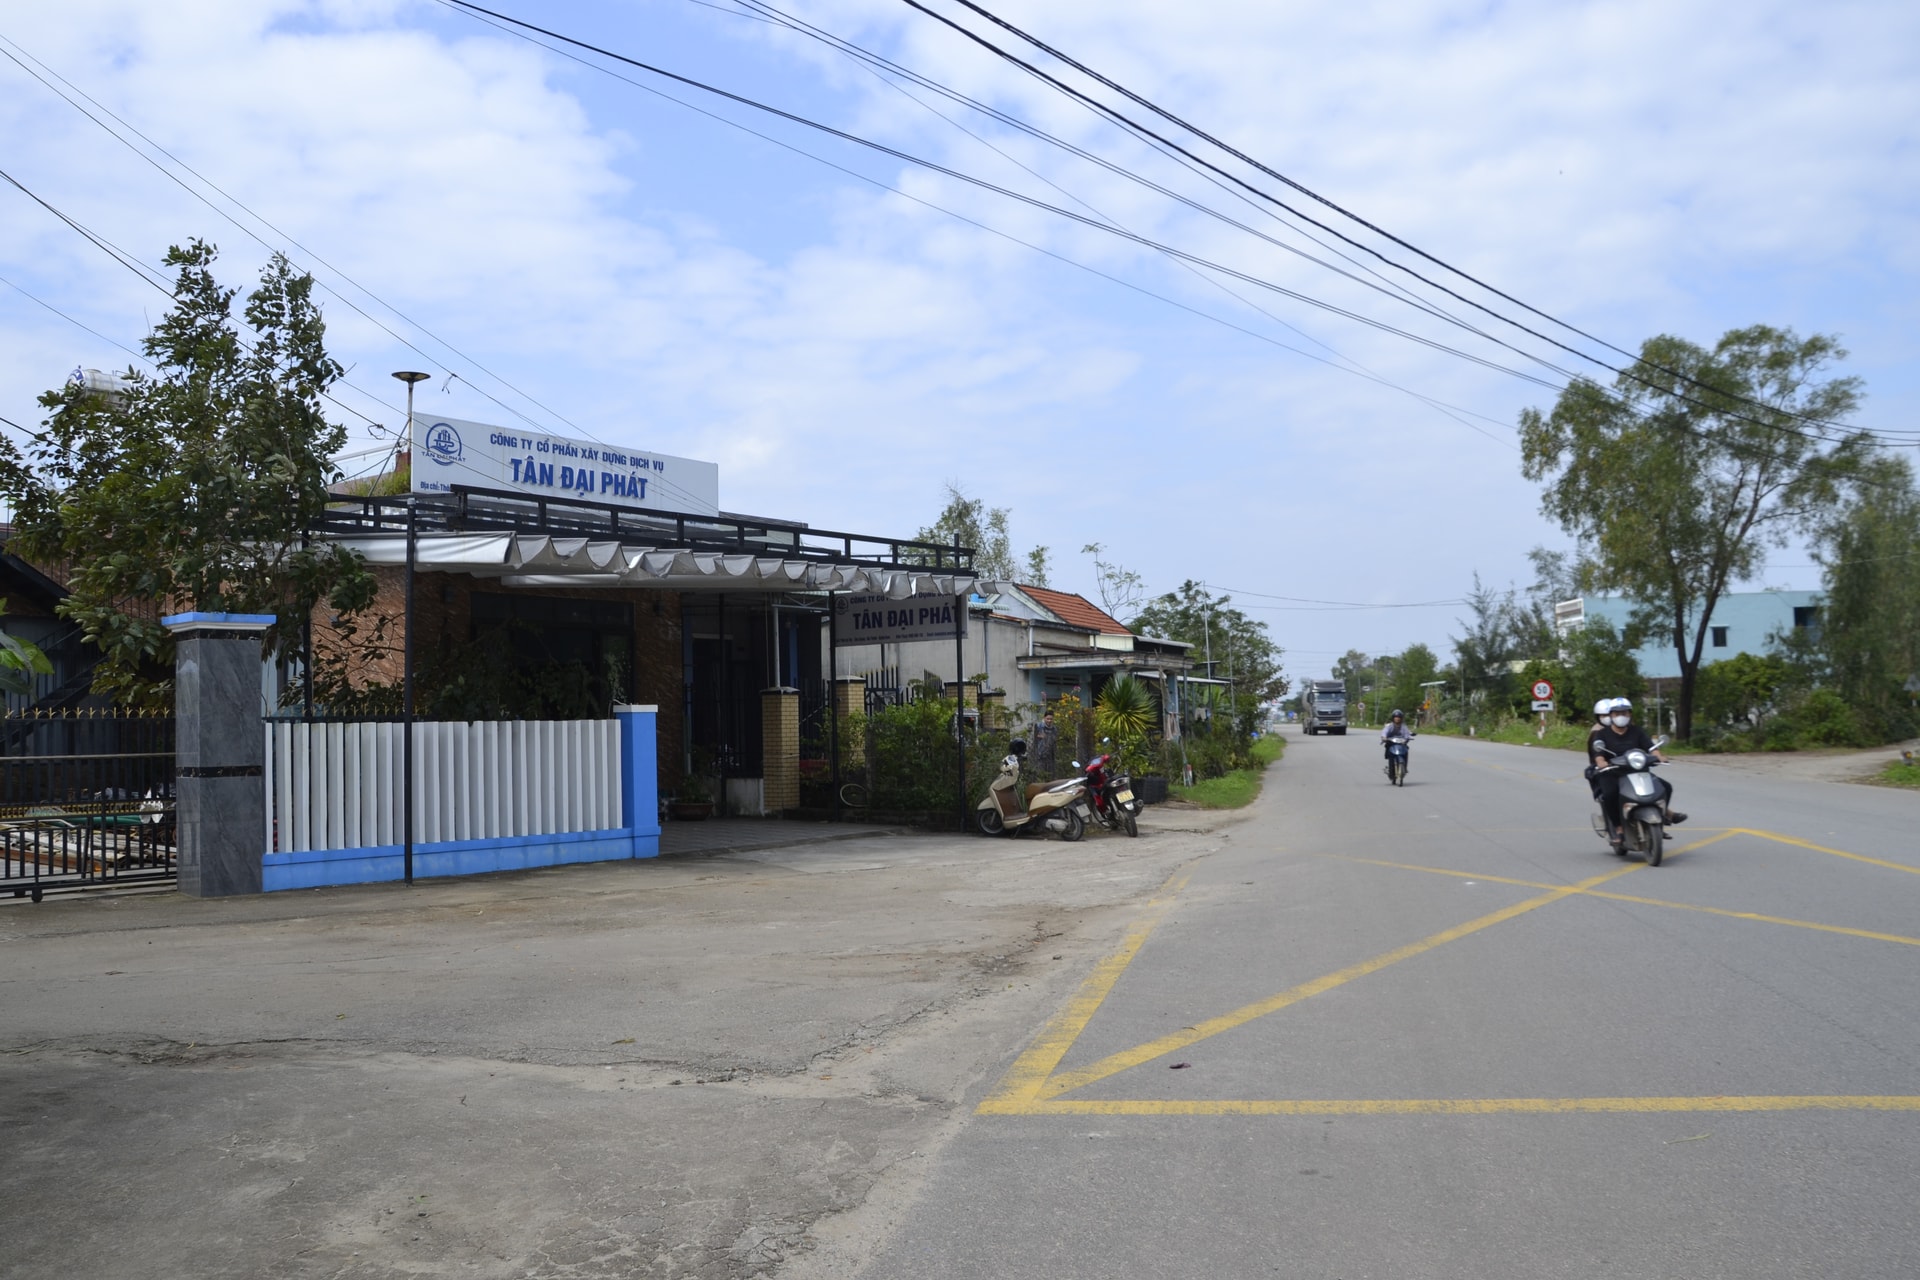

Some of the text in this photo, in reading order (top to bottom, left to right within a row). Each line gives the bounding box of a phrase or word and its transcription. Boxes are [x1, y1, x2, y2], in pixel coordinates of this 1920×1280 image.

[490, 432, 518, 448] CÔNG
[521, 438, 533, 450] TY
[581, 447, 599, 461] XÂY
[602, 451, 627, 466] DỰNG
[629, 456, 649, 469] DỊCH
[652, 460, 664, 473] VỤ
[511, 455, 648, 499] TÂN ĐẠI PHÁT
[853, 609, 883, 630] TÂN
[888, 608, 914, 630] ĐẠI
[1536, 685, 1548, 695] 50
